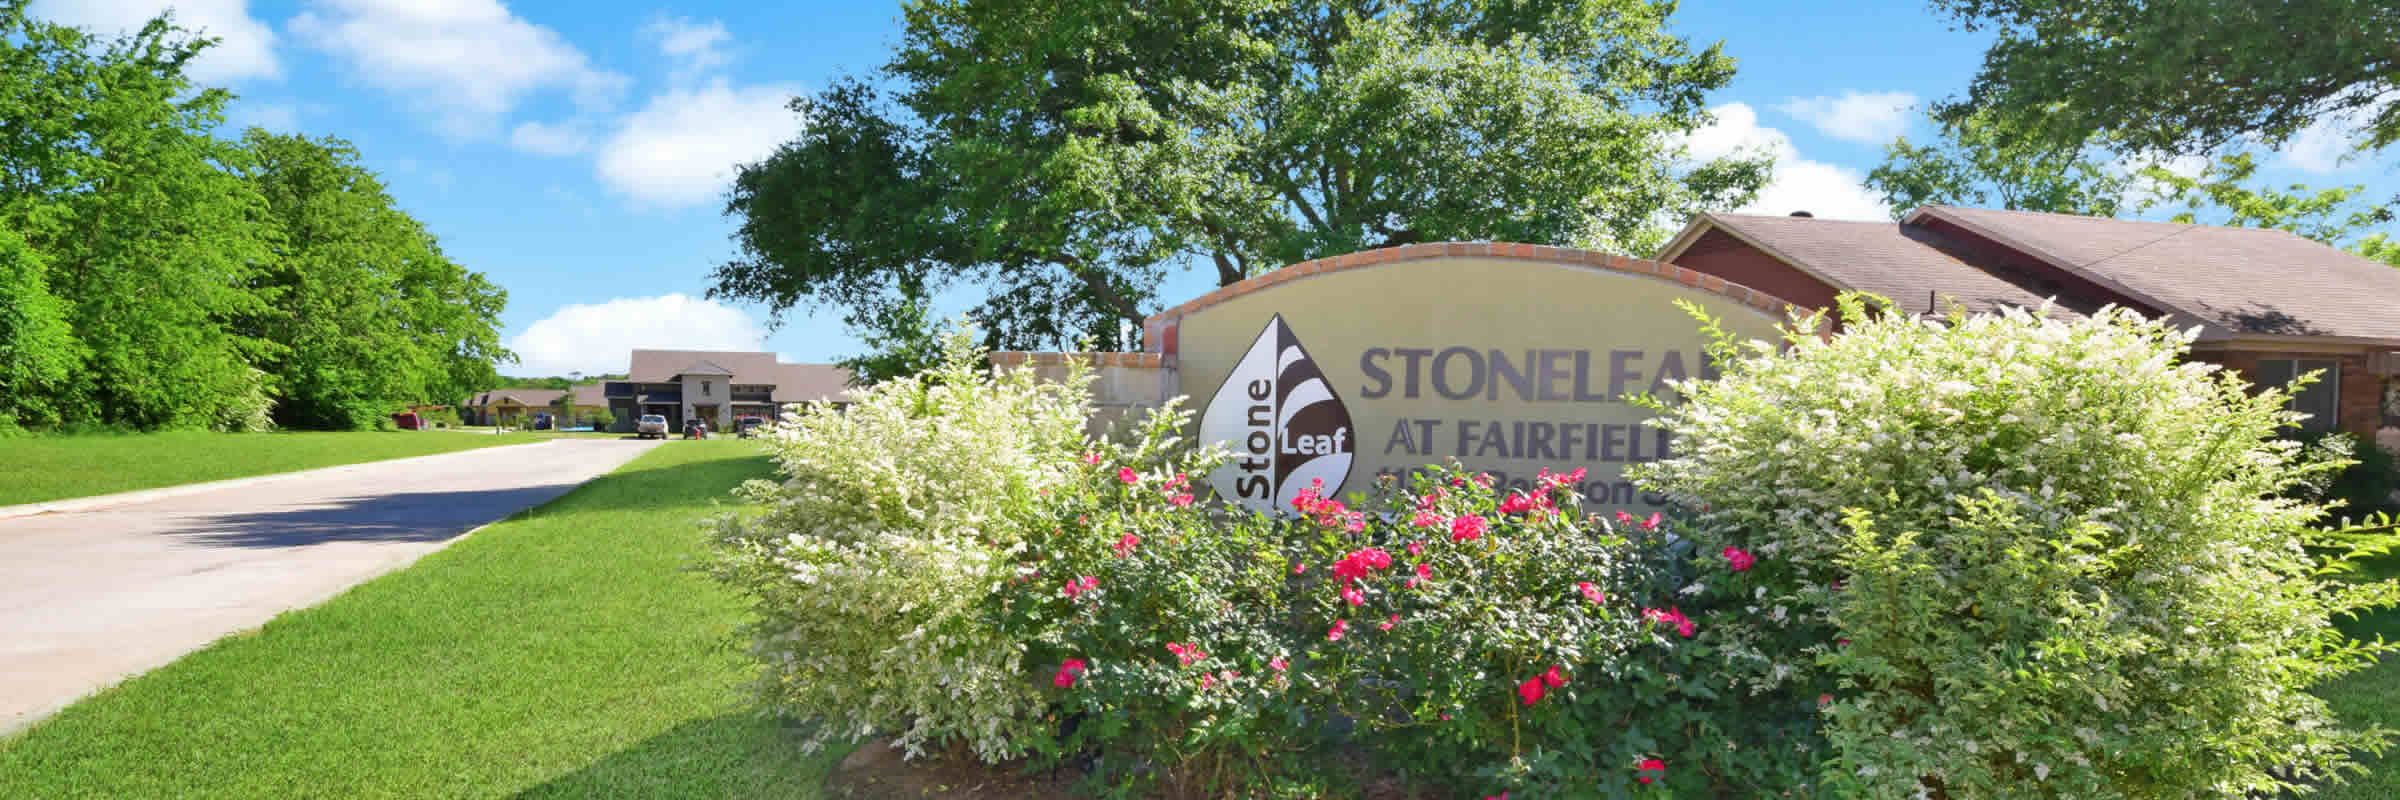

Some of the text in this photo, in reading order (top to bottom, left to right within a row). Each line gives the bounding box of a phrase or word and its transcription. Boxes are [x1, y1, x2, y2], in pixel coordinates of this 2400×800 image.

[1235, 378, 1271, 500] Stone
[1281, 425, 1347, 455] Leaf
[1383, 417, 1442, 456] AT
